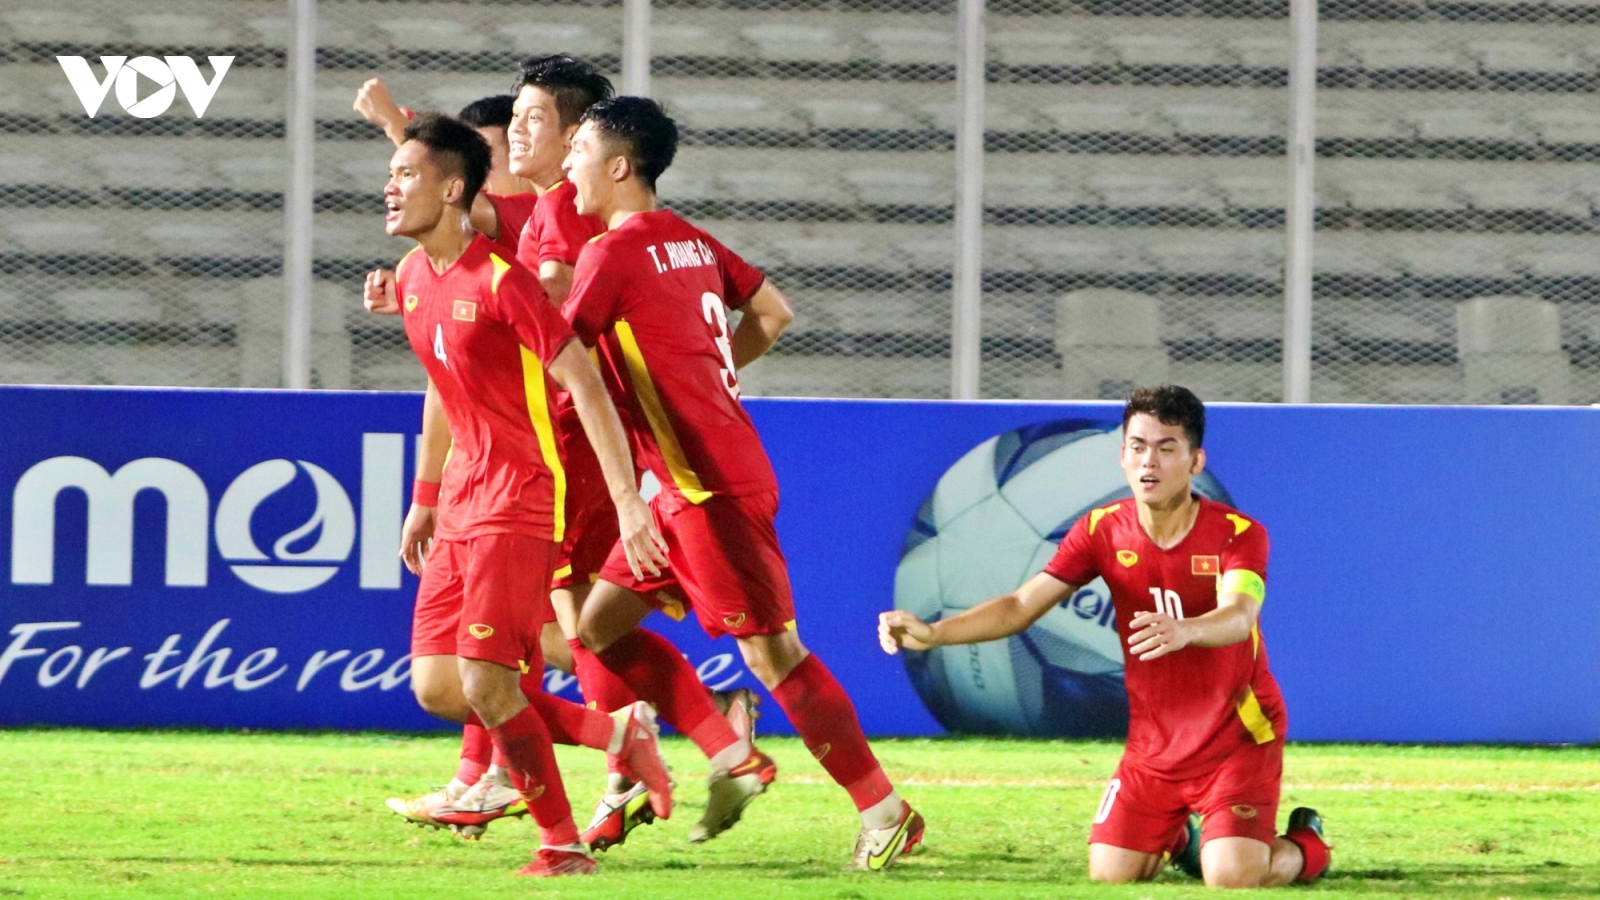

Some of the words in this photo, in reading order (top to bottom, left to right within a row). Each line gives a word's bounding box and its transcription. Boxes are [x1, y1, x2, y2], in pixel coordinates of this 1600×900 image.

[646, 245, 668, 274] T.
[433, 323, 450, 371] 4
[702, 291, 740, 401] 3
[1149, 587, 1185, 621] 10
[0, 621, 131, 691] For
[139, 618, 288, 691] the
